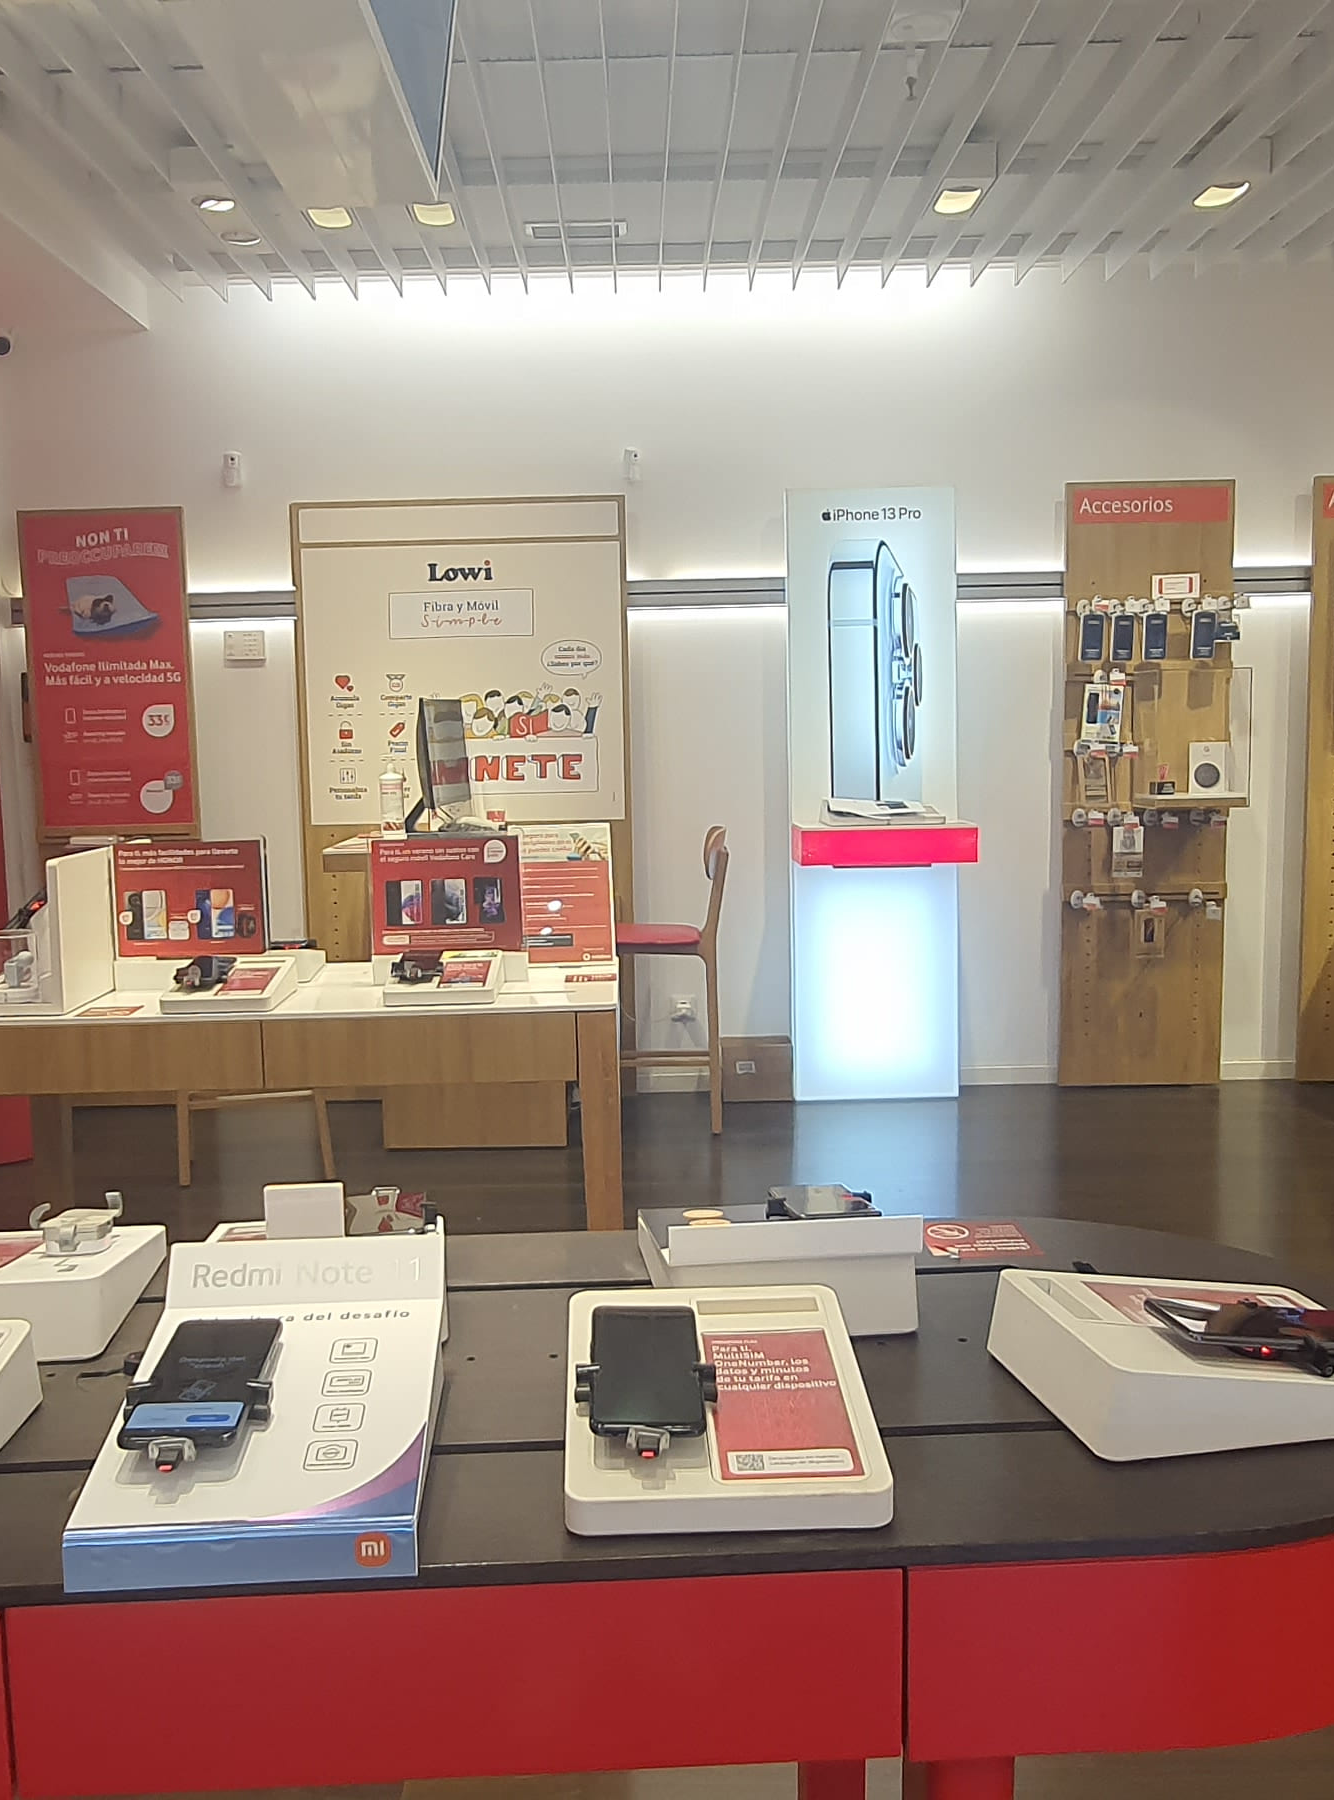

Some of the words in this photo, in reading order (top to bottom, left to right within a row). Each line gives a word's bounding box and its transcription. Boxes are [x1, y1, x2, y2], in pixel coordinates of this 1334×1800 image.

[1079, 496, 1174, 515] Accesorios
[833, 508, 880, 522] iPhone
[881, 507, 896, 520] 13
[899, 507, 922, 520] Pro
[75, 530, 110, 548] NON
[113, 528, 129, 541] TI
[427, 560, 493, 582] Lowi
[423, 601, 454, 612] Fibra
[456, 602, 463, 614] y
[467, 600, 499, 611] Móvil
[44, 662, 96, 673] Vodafone
[98, 660, 148, 671] Ilimitada
[149, 659, 175, 670] Max.
[45, 675, 67, 686] Más
[69, 674, 93, 685] fácil
[95, 676, 102, 687] y
[103, 675, 111, 685] a
[112, 672, 164, 684] velocidad
[166, 672, 182, 683] 5G
[471, 753, 583, 782] NETE
[191, 1261, 282, 1289] Redmi
[296, 1260, 374, 1287] Note
[303, 1312, 332, 1322] del
[712, 1345, 738, 1353] Para
[790, 1357, 809, 1366] los
[716, 1367, 748, 1376] datos
[760, 1366, 810, 1375] minutos
[716, 1376, 732, 1384] de
[733, 1375, 746, 1383] tu
[748, 1374, 781, 1382] tarifa
[717, 1383, 771, 1392] cualquier
[773, 1379, 837, 1390] dispositivo
